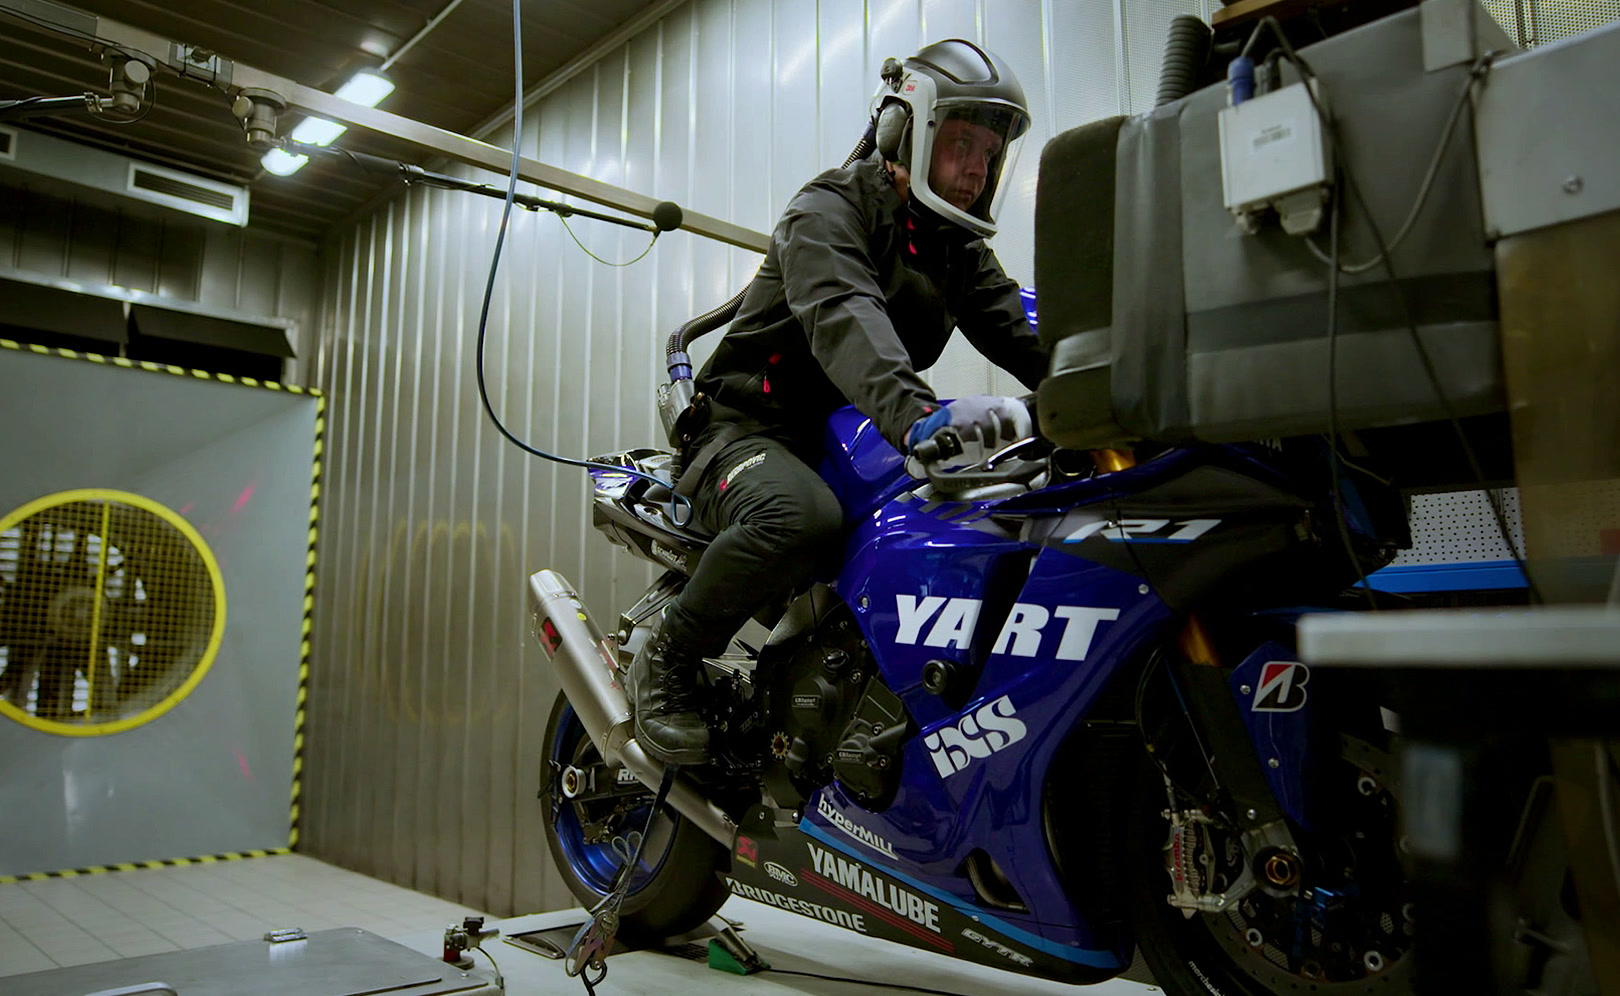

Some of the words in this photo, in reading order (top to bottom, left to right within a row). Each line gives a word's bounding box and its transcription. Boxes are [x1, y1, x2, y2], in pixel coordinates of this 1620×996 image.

[1063, 519, 1222, 544] R1
[895, 594, 1121, 661] YART
[767, 863, 796, 884] BMC
[1172, 832, 1184, 880] brembo
[725, 877, 867, 932] BRIDGESTONE
[807, 842, 941, 934] YAMALUBE
[961, 928, 1034, 968] GYTR
